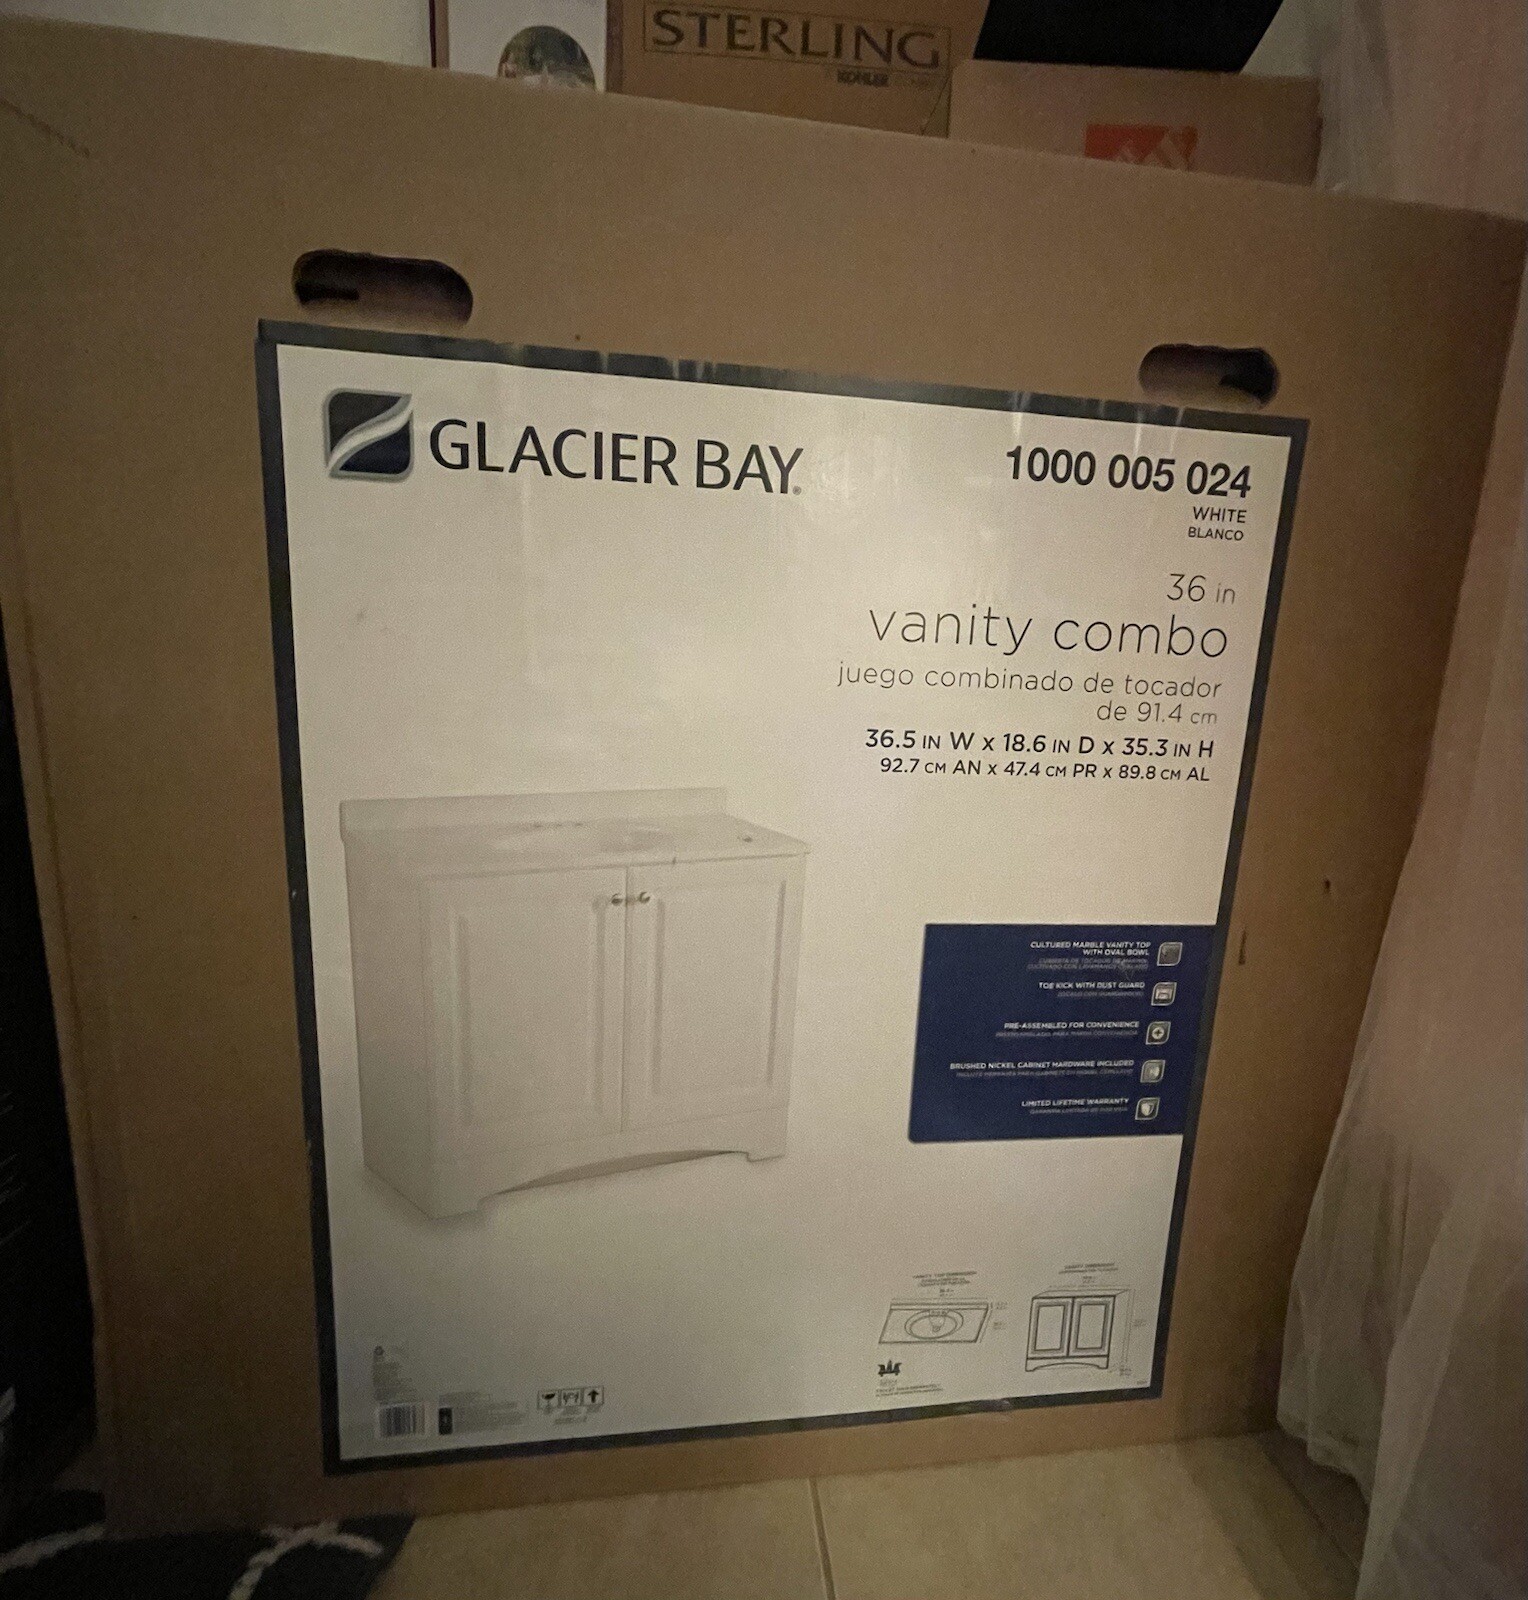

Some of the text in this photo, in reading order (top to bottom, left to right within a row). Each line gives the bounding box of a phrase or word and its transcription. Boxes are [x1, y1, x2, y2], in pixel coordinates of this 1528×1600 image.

[652, 9, 940, 69] STERLING
[428, 418, 803, 496] GLACIER BAY
[1006, 445, 1251, 498] 1000 005 024
[1192, 506, 1247, 524] WHITE
[1187, 526, 1245, 542] BLANCO
[1166, 573, 1236, 605] 36 in
[869, 603, 1228, 658] vanity combo
[837, 661, 1222, 698] juego combinado de tocador
[1096, 701, 1218, 725] de 91.4 cm
[865, 728, 1214, 759] 36.5 IN W x 18.6 IN D x 35.3 IN H
[880, 757, 1210, 782] 92.7 CM AN x 47.4 CM PR x 89.8 CM AL
[1030, 941, 1151, 949] CULTURED MARBLE VANITY TOP
[1118, 981, 1145, 989] GUARD
[1004, 1020, 1139, 1029] PRE-ASSEMBLED FOR CONVENIENCE
[950, 1059, 1134, 1070] BRUSHED NICKEL CABINET HARDWARE INCLUDED
[1021, 1099, 1050, 1107] LIMITED
[1052, 1098, 1084, 1106] LIFETIME
